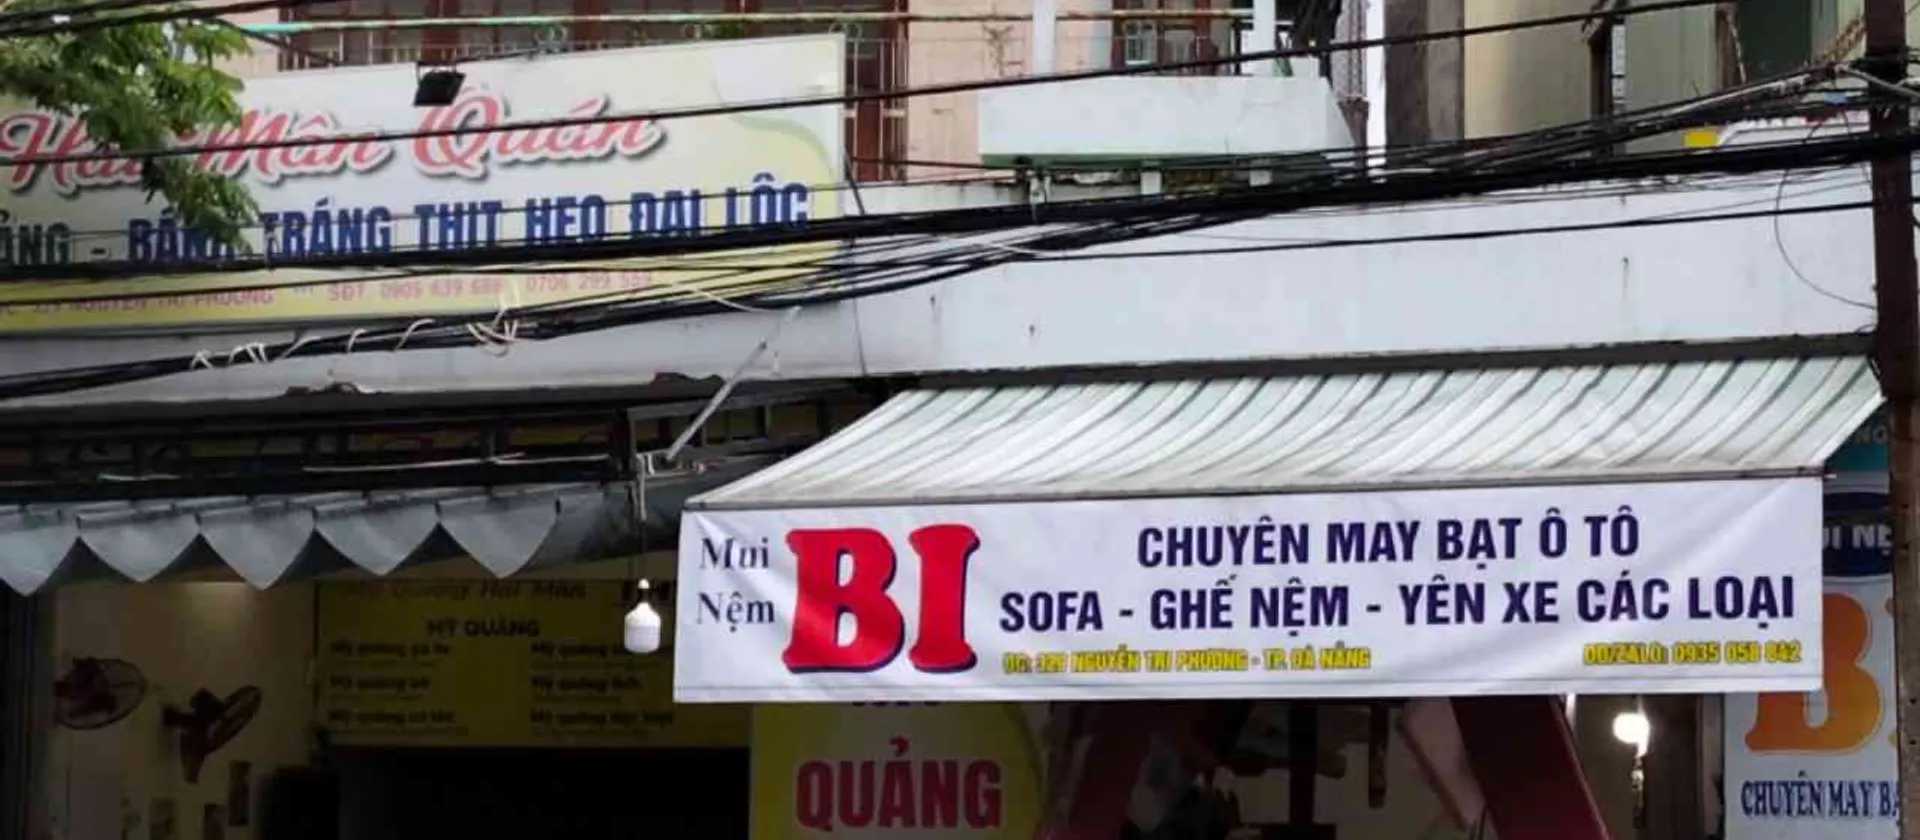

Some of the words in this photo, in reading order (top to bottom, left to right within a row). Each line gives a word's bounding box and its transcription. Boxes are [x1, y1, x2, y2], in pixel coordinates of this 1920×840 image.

[411, 91, 658, 171] Quán
[259, 197, 391, 256] TRÁNG
[700, 536, 770, 570] Mui
[1138, 515, 1309, 567] CHUYÊN
[1327, 520, 1420, 563] MAY
[1437, 517, 1522, 568] BẠT
[1539, 507, 1567, 559] Ô
[1584, 504, 1639, 557] TÔ
[696, 591, 776, 632] Nệm
[782, 524, 980, 674] BI
[1000, 590, 1103, 632] SOFA
[1149, 573, 1237, 630] GHẾ
[1250, 577, 1349, 637] NỆM
[1399, 575, 1485, 625] YÊN
[1502, 581, 1558, 624] XE
[1577, 570, 1669, 620] CÁC
[1688, 576, 1794, 628] LOẠI
[1672, 641, 1720, 664] 0935
[796, 736, 1002, 832] QUẢNG
[1740, 769, 1822, 818] CHUYÊN
[1828, 780, 1873, 817] MAY
